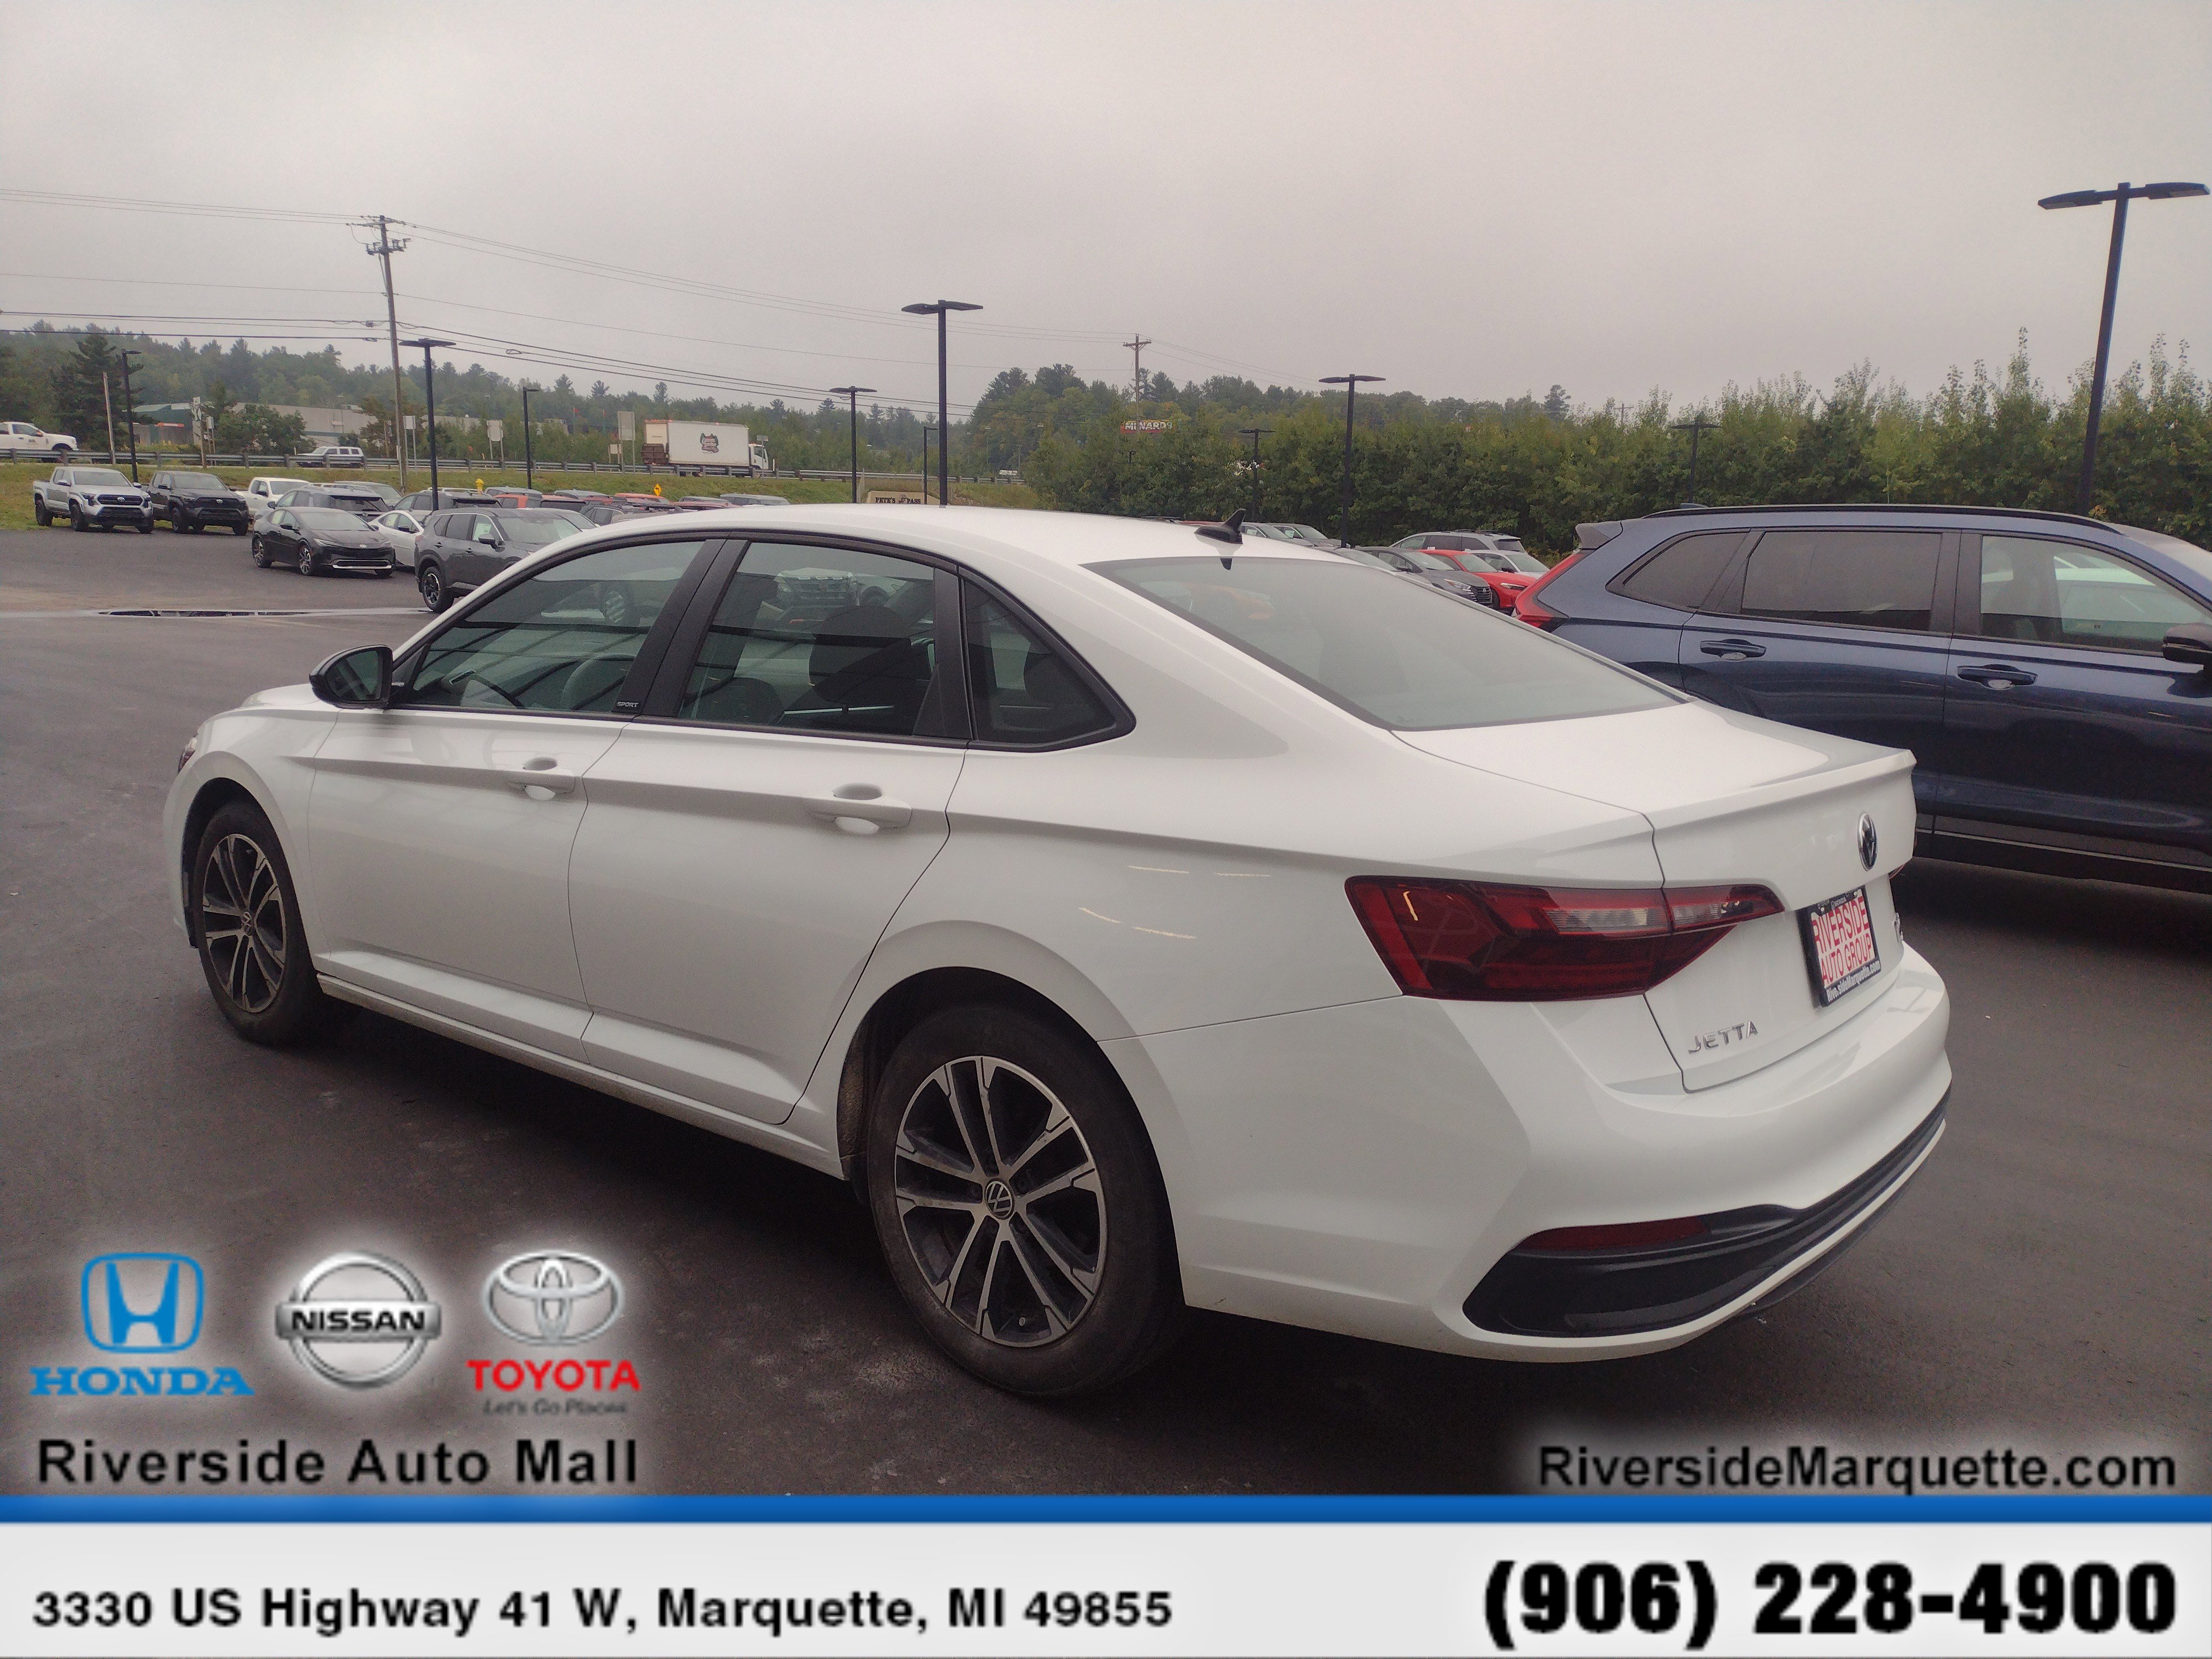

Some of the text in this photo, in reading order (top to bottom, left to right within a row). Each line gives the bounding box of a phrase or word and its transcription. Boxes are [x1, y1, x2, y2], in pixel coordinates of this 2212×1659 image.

[1811, 895, 1870, 954] RIVERSIDE
[1821, 932, 1872, 984] AUTO GROUP
[1688, 1020, 1758, 1054] JETTA
